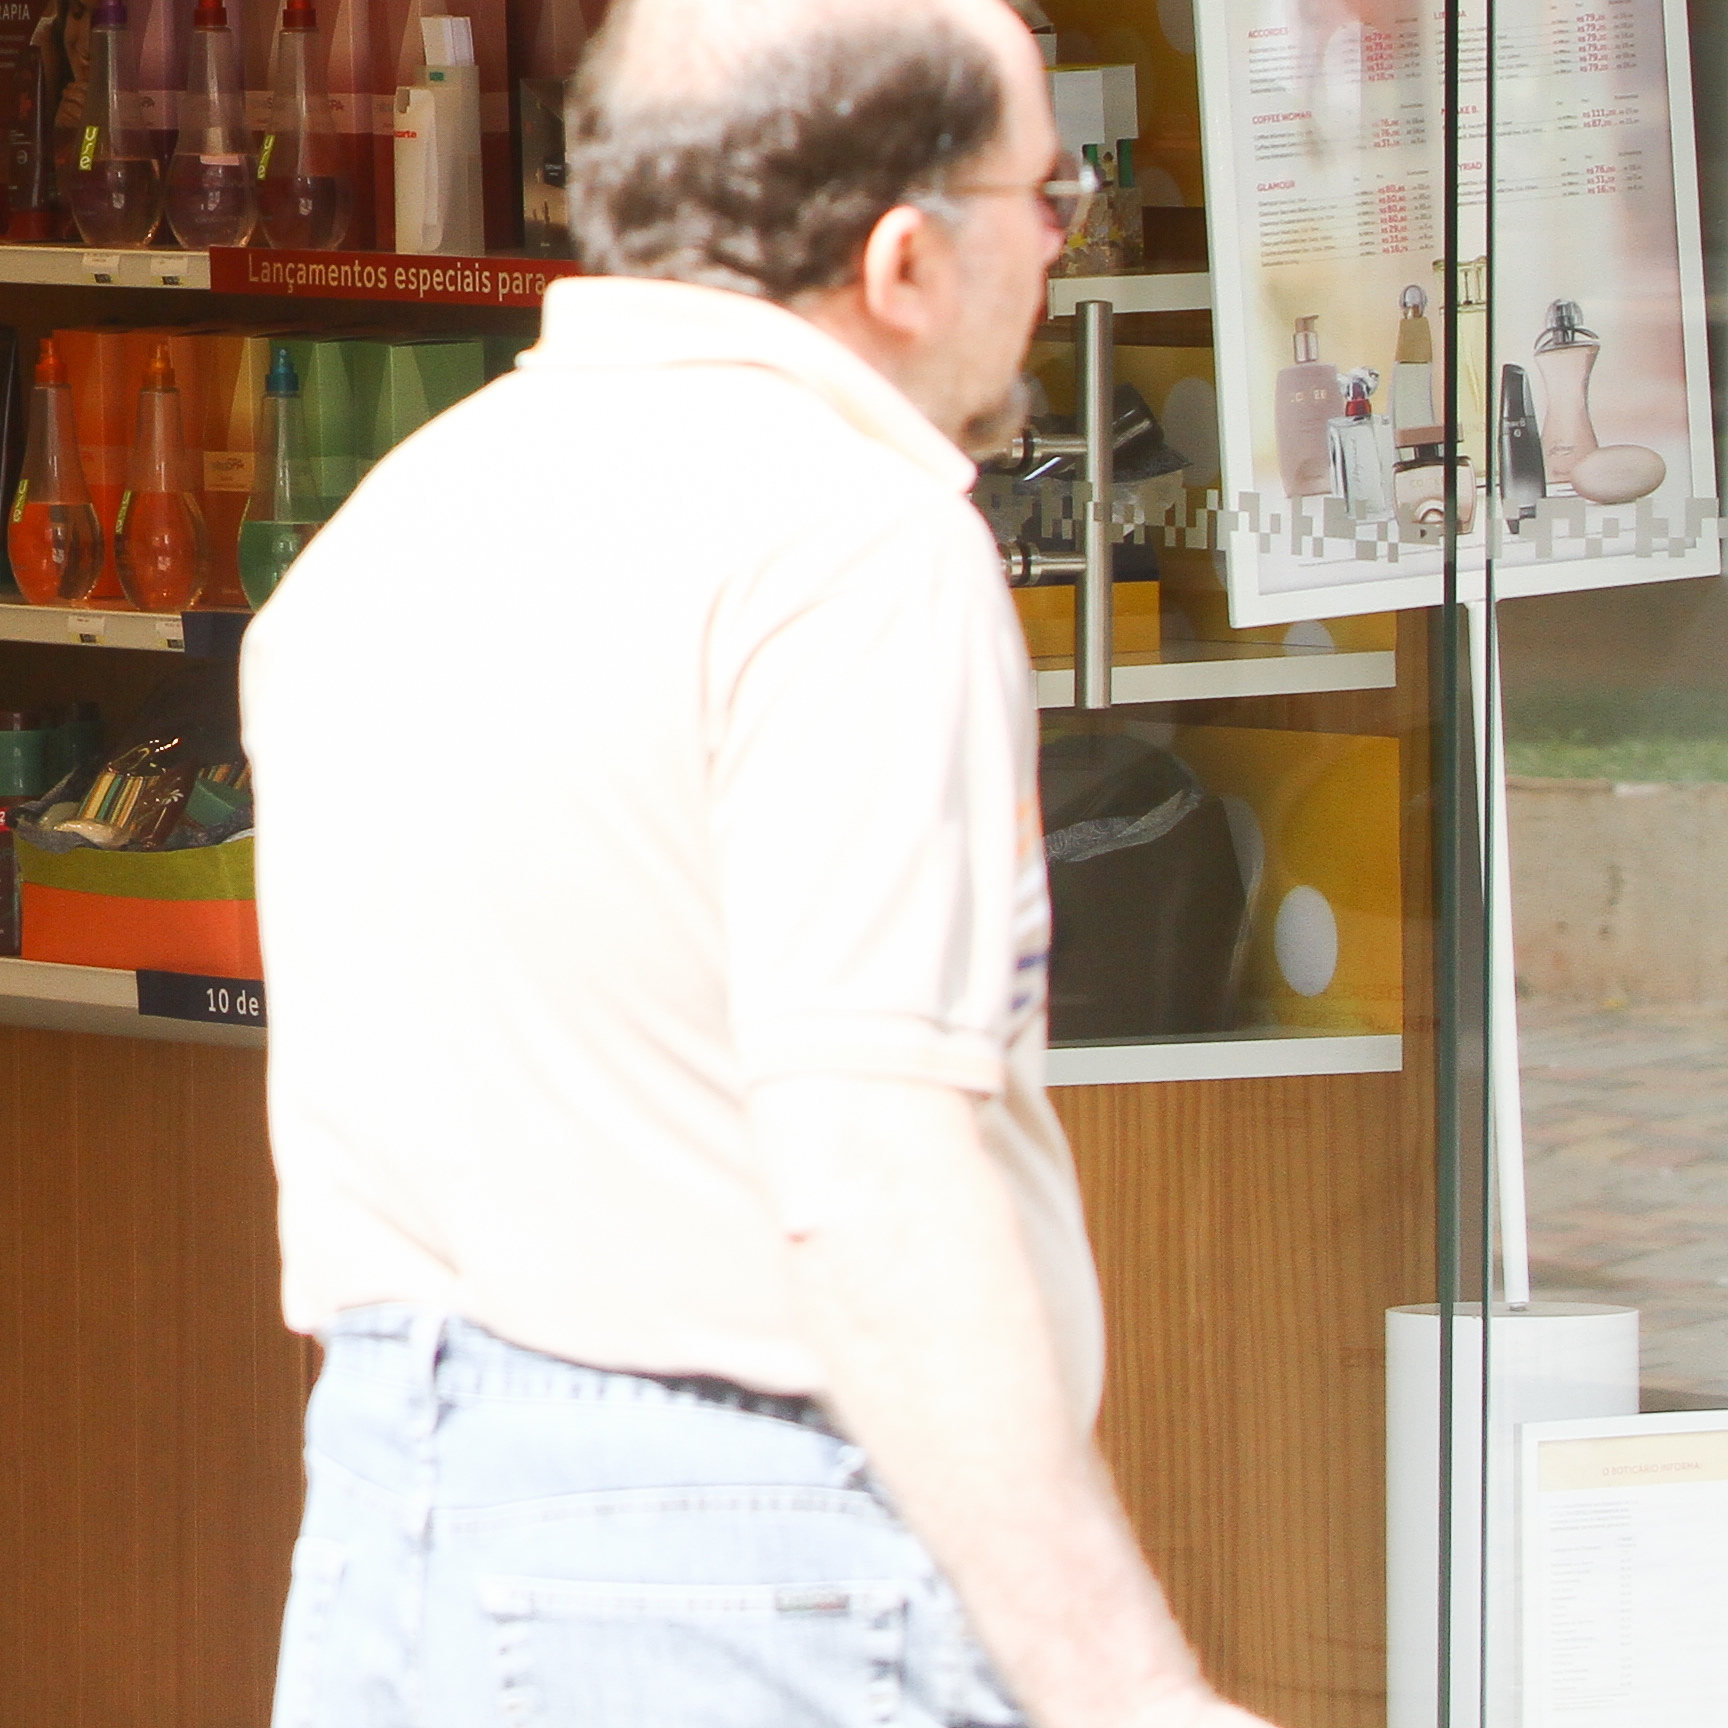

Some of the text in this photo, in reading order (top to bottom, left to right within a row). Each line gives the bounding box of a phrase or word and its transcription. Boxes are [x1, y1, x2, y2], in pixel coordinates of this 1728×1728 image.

[247, 252, 545, 302] Lançamentos especiais para
[206, 987, 261, 1017] 10 de
